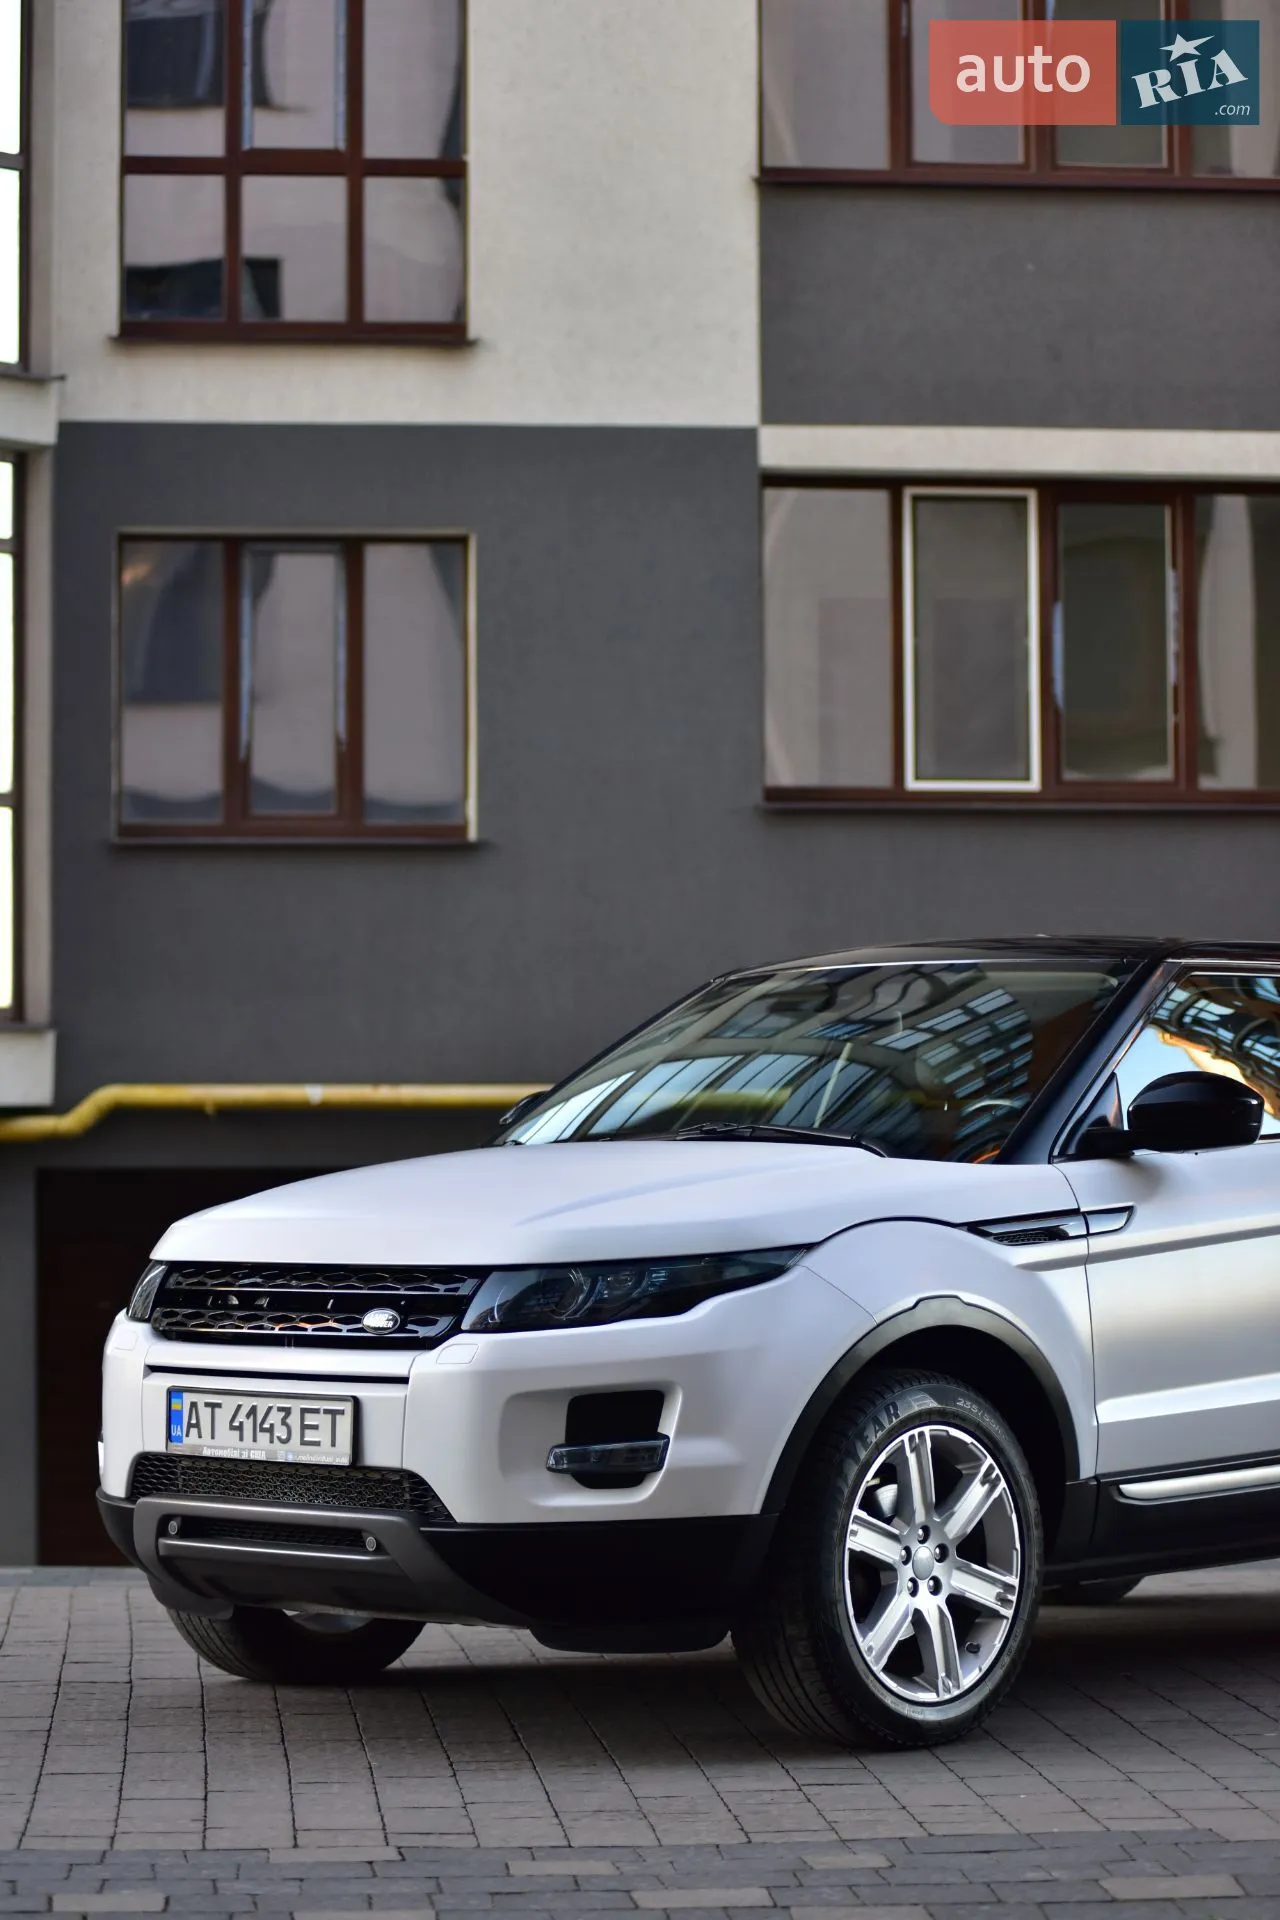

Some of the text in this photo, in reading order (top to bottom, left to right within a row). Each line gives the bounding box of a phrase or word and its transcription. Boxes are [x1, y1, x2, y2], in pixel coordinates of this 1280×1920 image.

[171, 1424, 183, 1437] UA
[185, 1400, 346, 1448] AT 4143 ET
